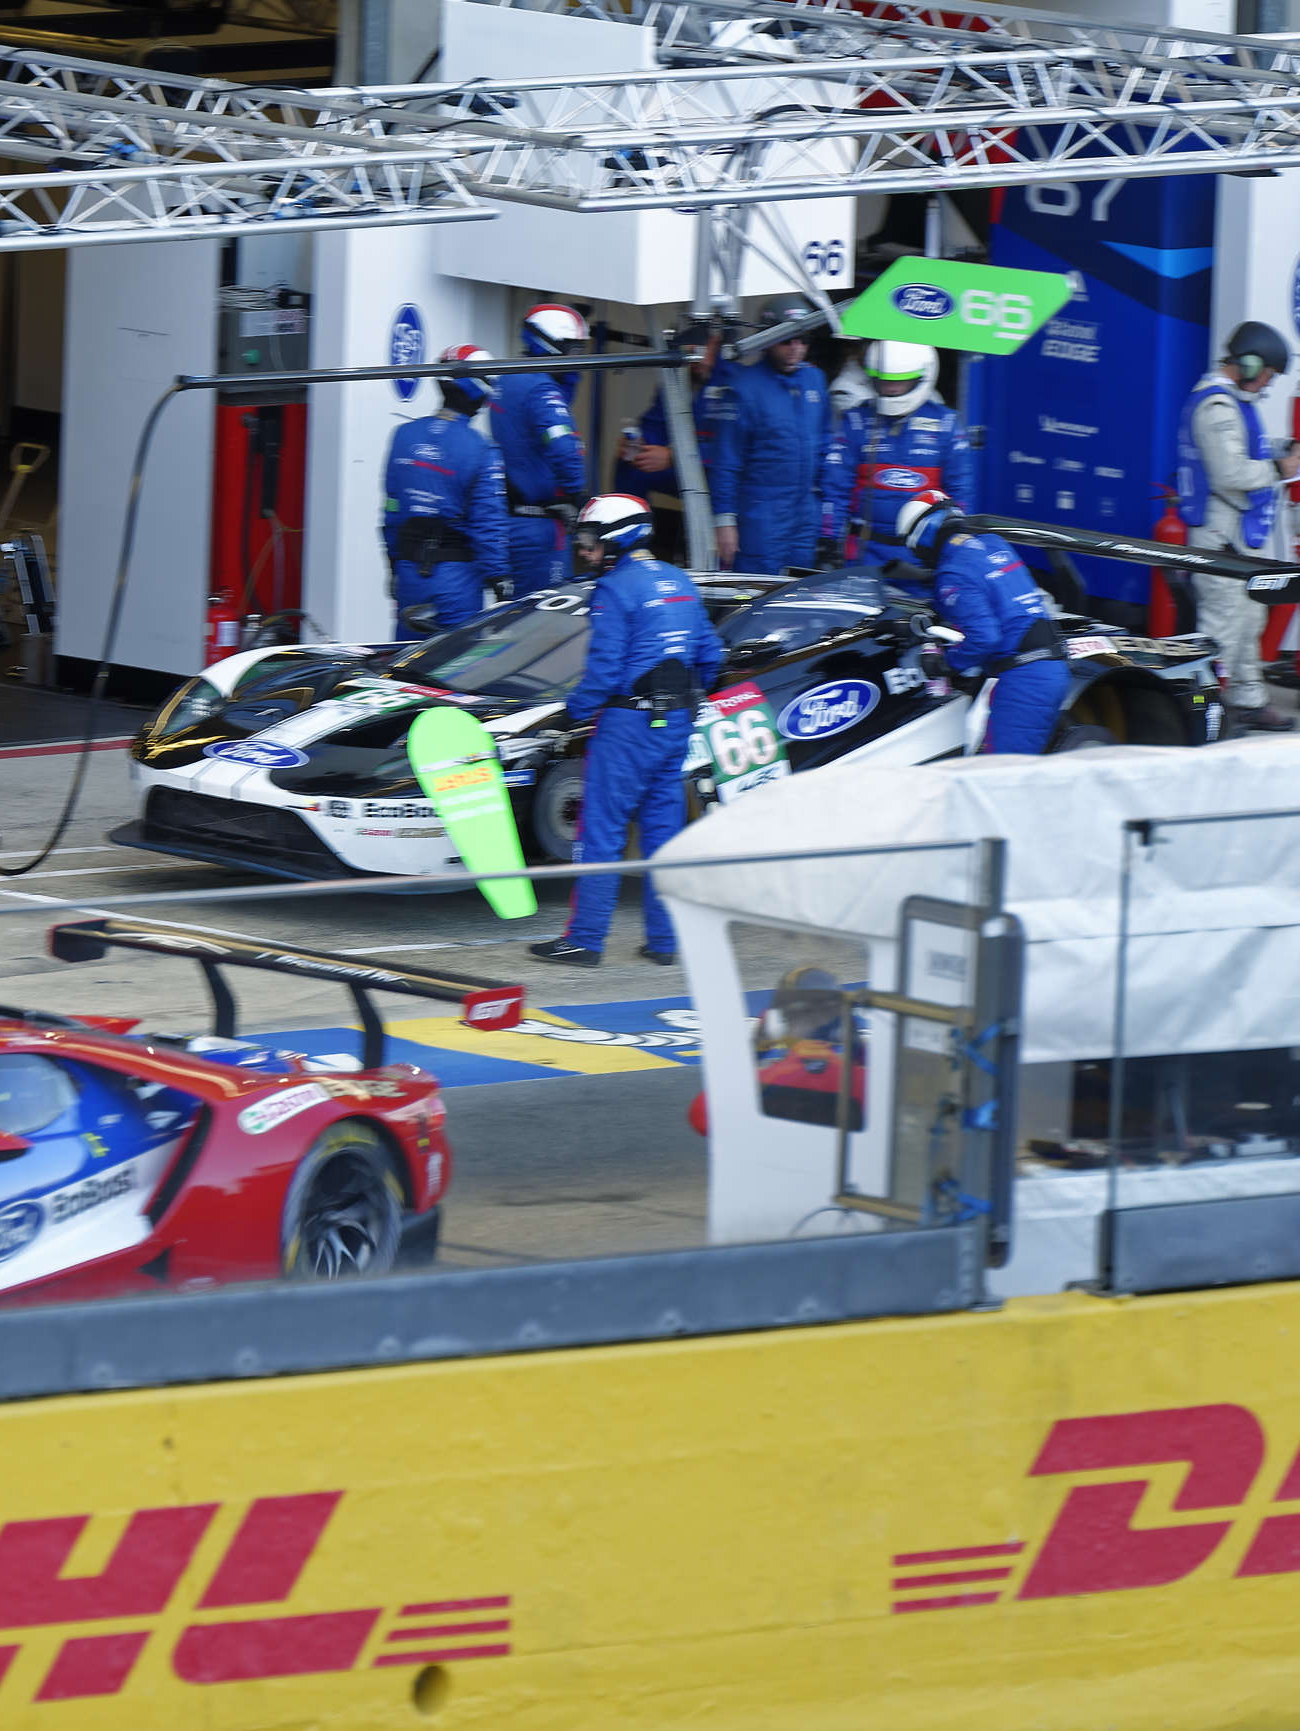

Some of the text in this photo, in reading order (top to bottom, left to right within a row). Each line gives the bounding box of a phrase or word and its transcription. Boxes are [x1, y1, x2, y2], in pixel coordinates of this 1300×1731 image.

[804, 239, 845, 277] 66
[960, 289, 1033, 331] 66
[1041, 339, 1100, 362] EDGE
[797, 688, 863, 734] Ford
[709, 709, 779, 776] 66
